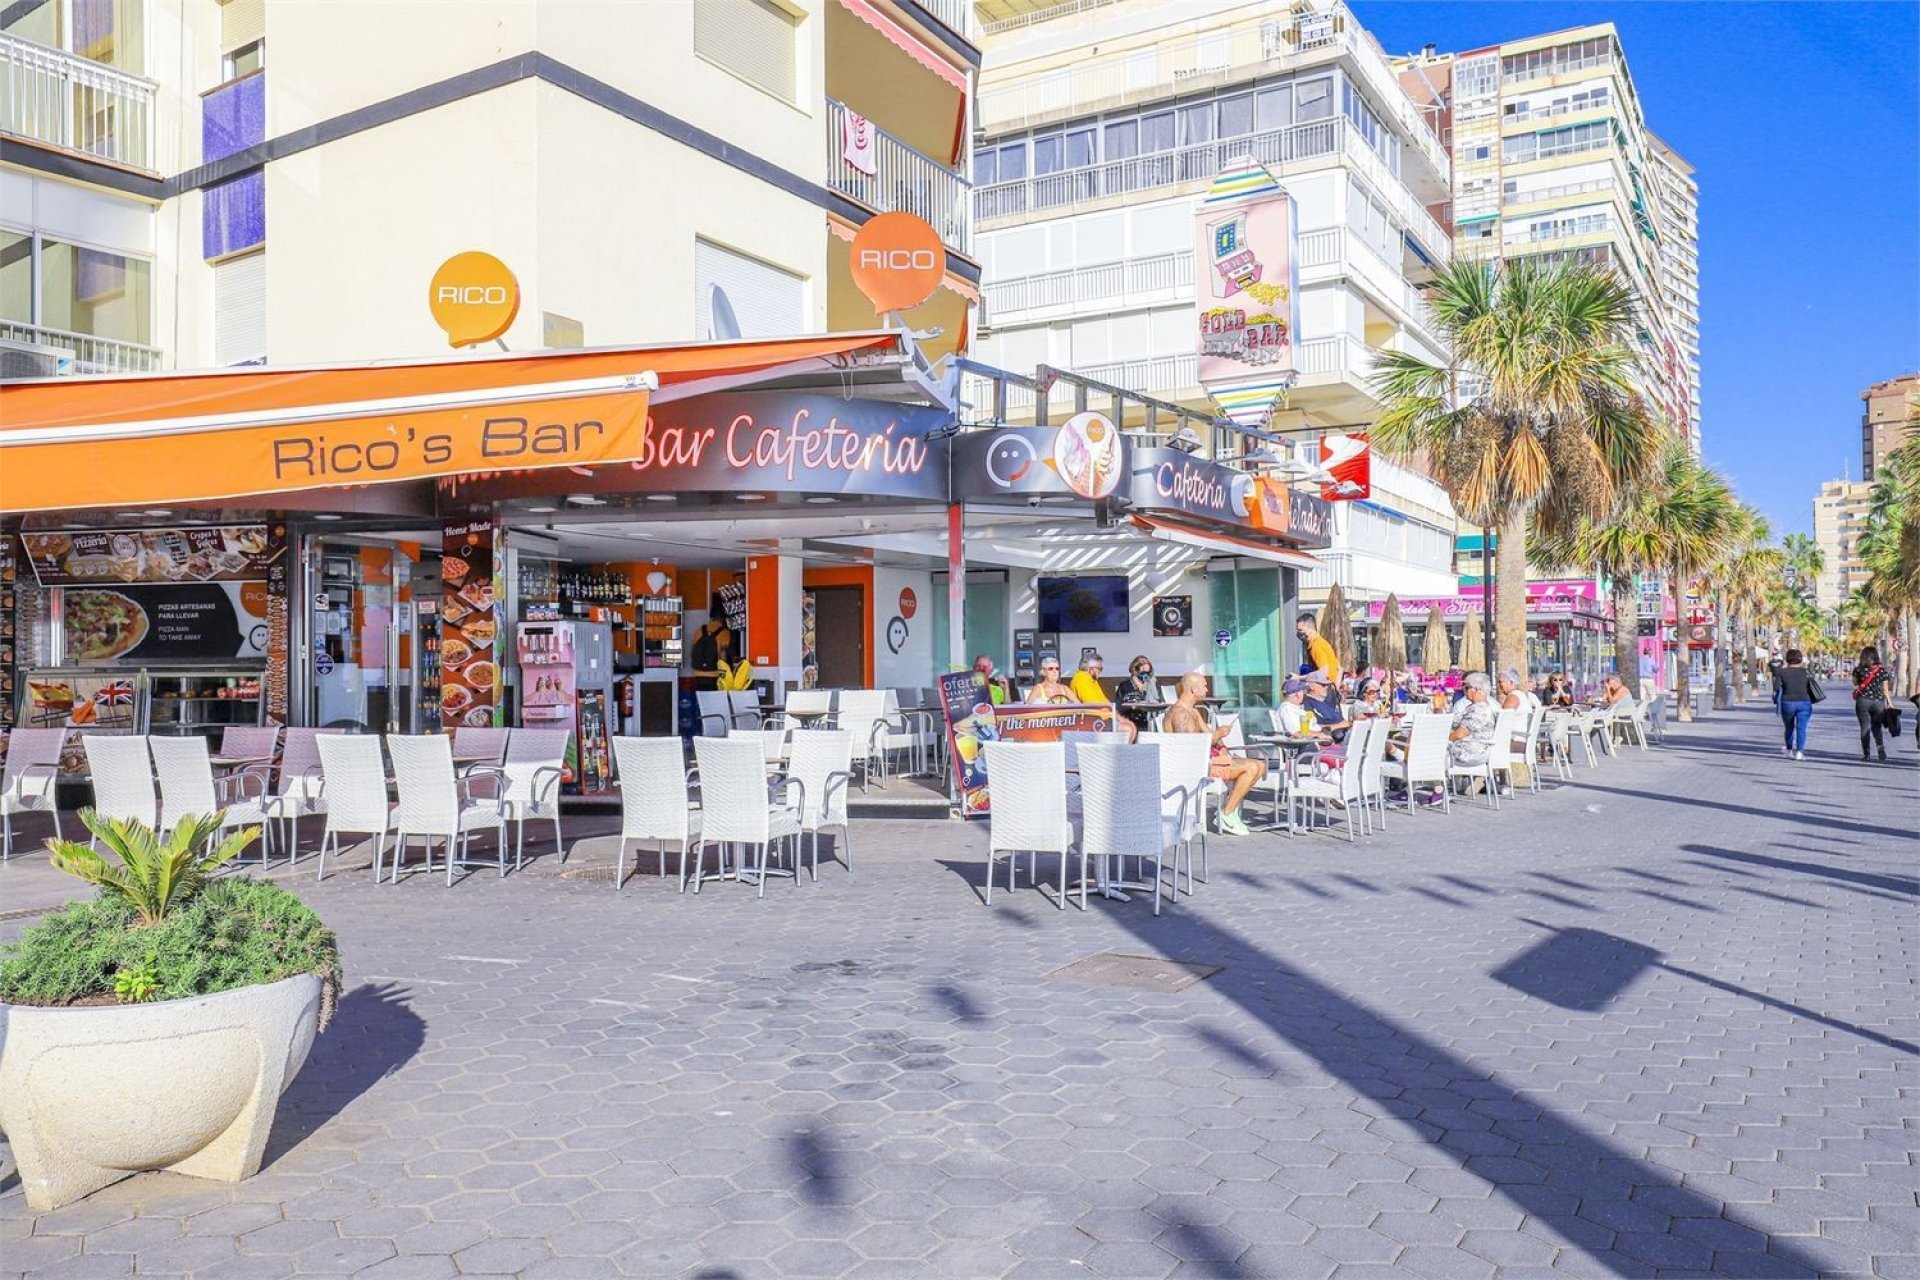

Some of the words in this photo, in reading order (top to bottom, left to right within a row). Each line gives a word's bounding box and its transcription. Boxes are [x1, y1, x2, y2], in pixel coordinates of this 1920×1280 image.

[861, 250, 934, 270] RICO
[438, 286, 506, 304] RICO
[1247, 324, 1289, 349] BAR
[273, 427, 452, 479] Rico's
[481, 416, 604, 458] Bar
[725, 408, 928, 481] Cafetería
[1156, 461, 1226, 509] Cafetería
[444, 526, 468, 537] Home
[469, 521, 492, 532] Made
[943, 676, 985, 691] oferta
[1007, 716, 1025, 730] the
[1027, 713, 1077, 729] moment
